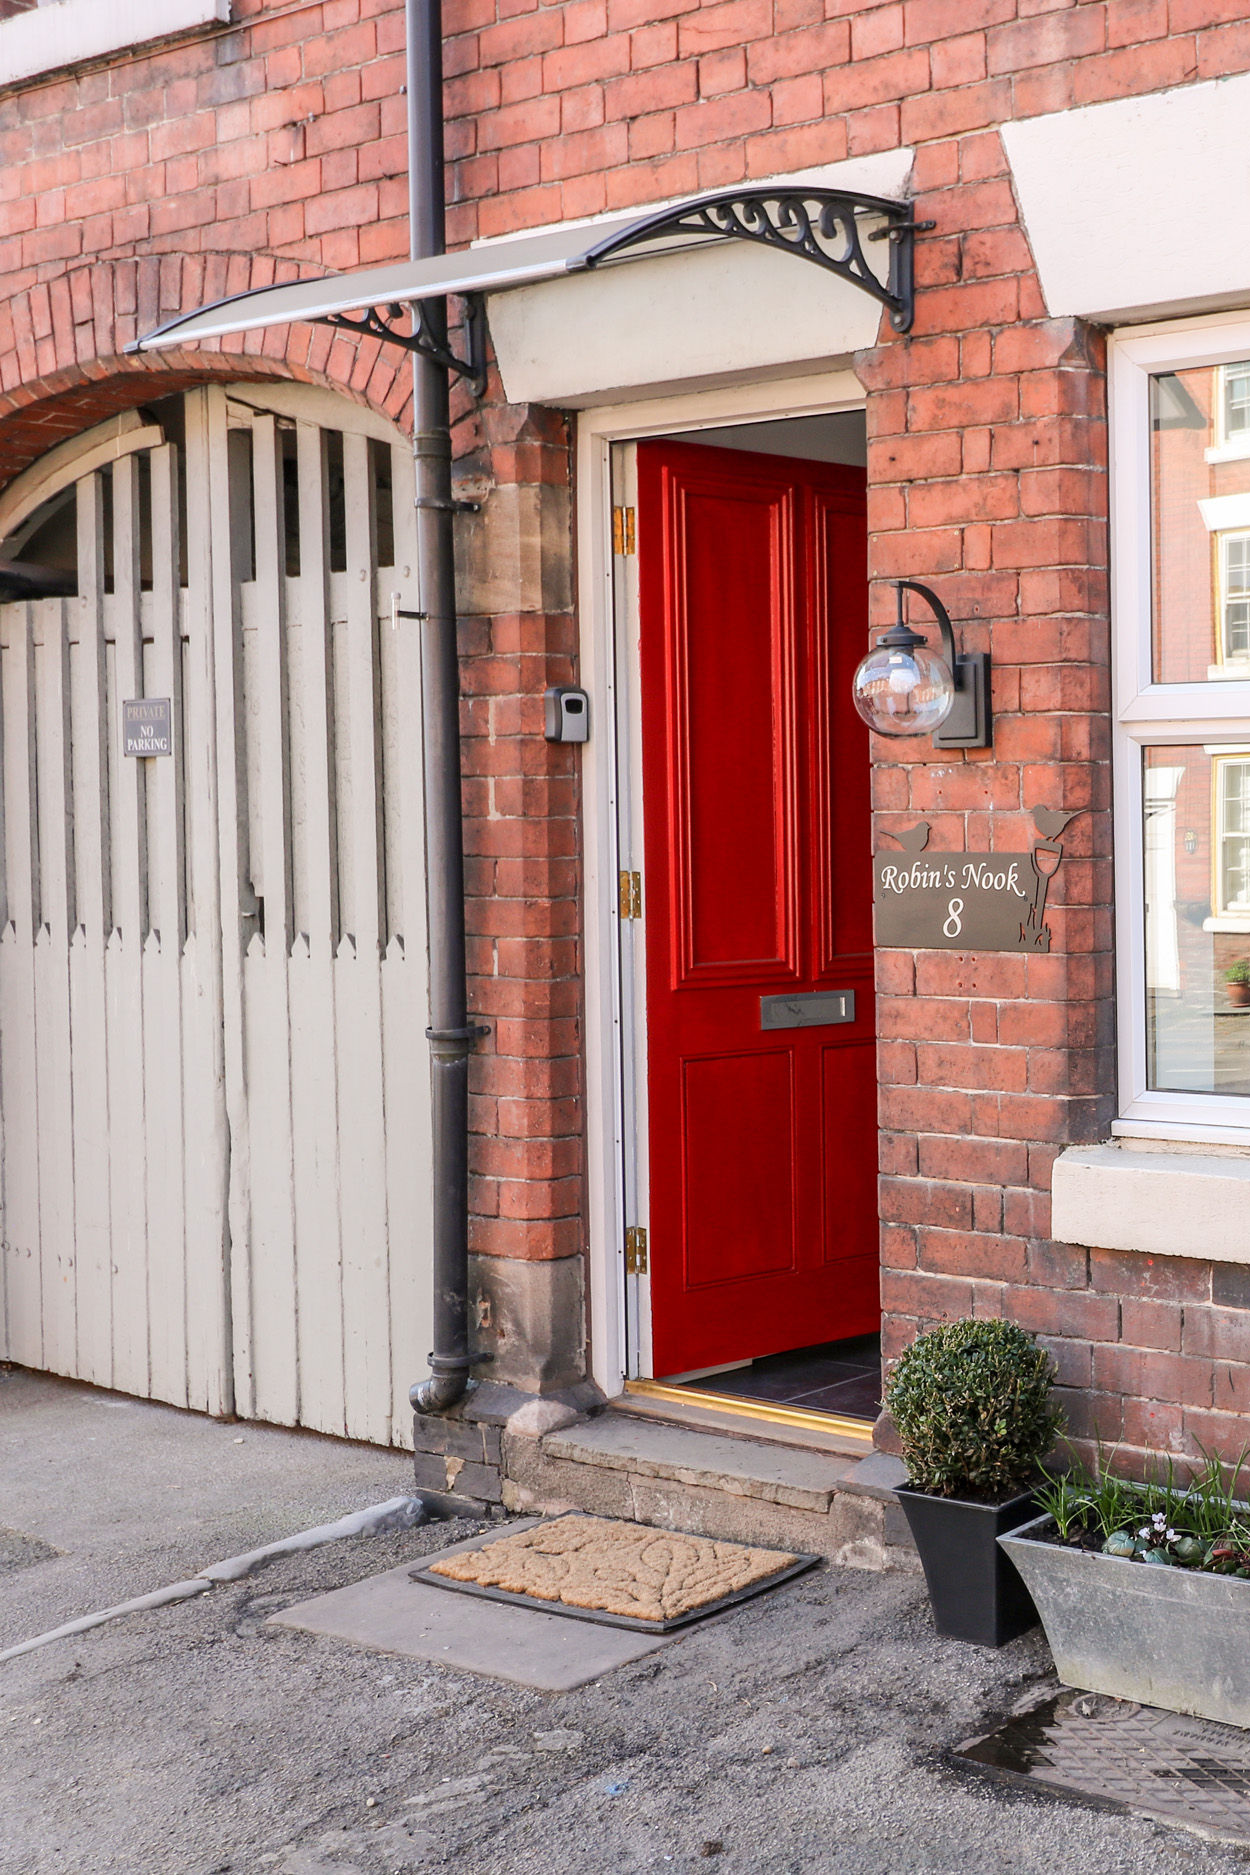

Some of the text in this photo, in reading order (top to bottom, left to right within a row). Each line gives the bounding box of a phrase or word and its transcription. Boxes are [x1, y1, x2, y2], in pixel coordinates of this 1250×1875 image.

[127, 705, 166, 719] PRIVATE
[140, 725, 154, 738] NO
[127, 738, 167, 751] PARKING
[881, 861, 1026, 897] Robin's Nook
[943, 898, 965, 938] 8
